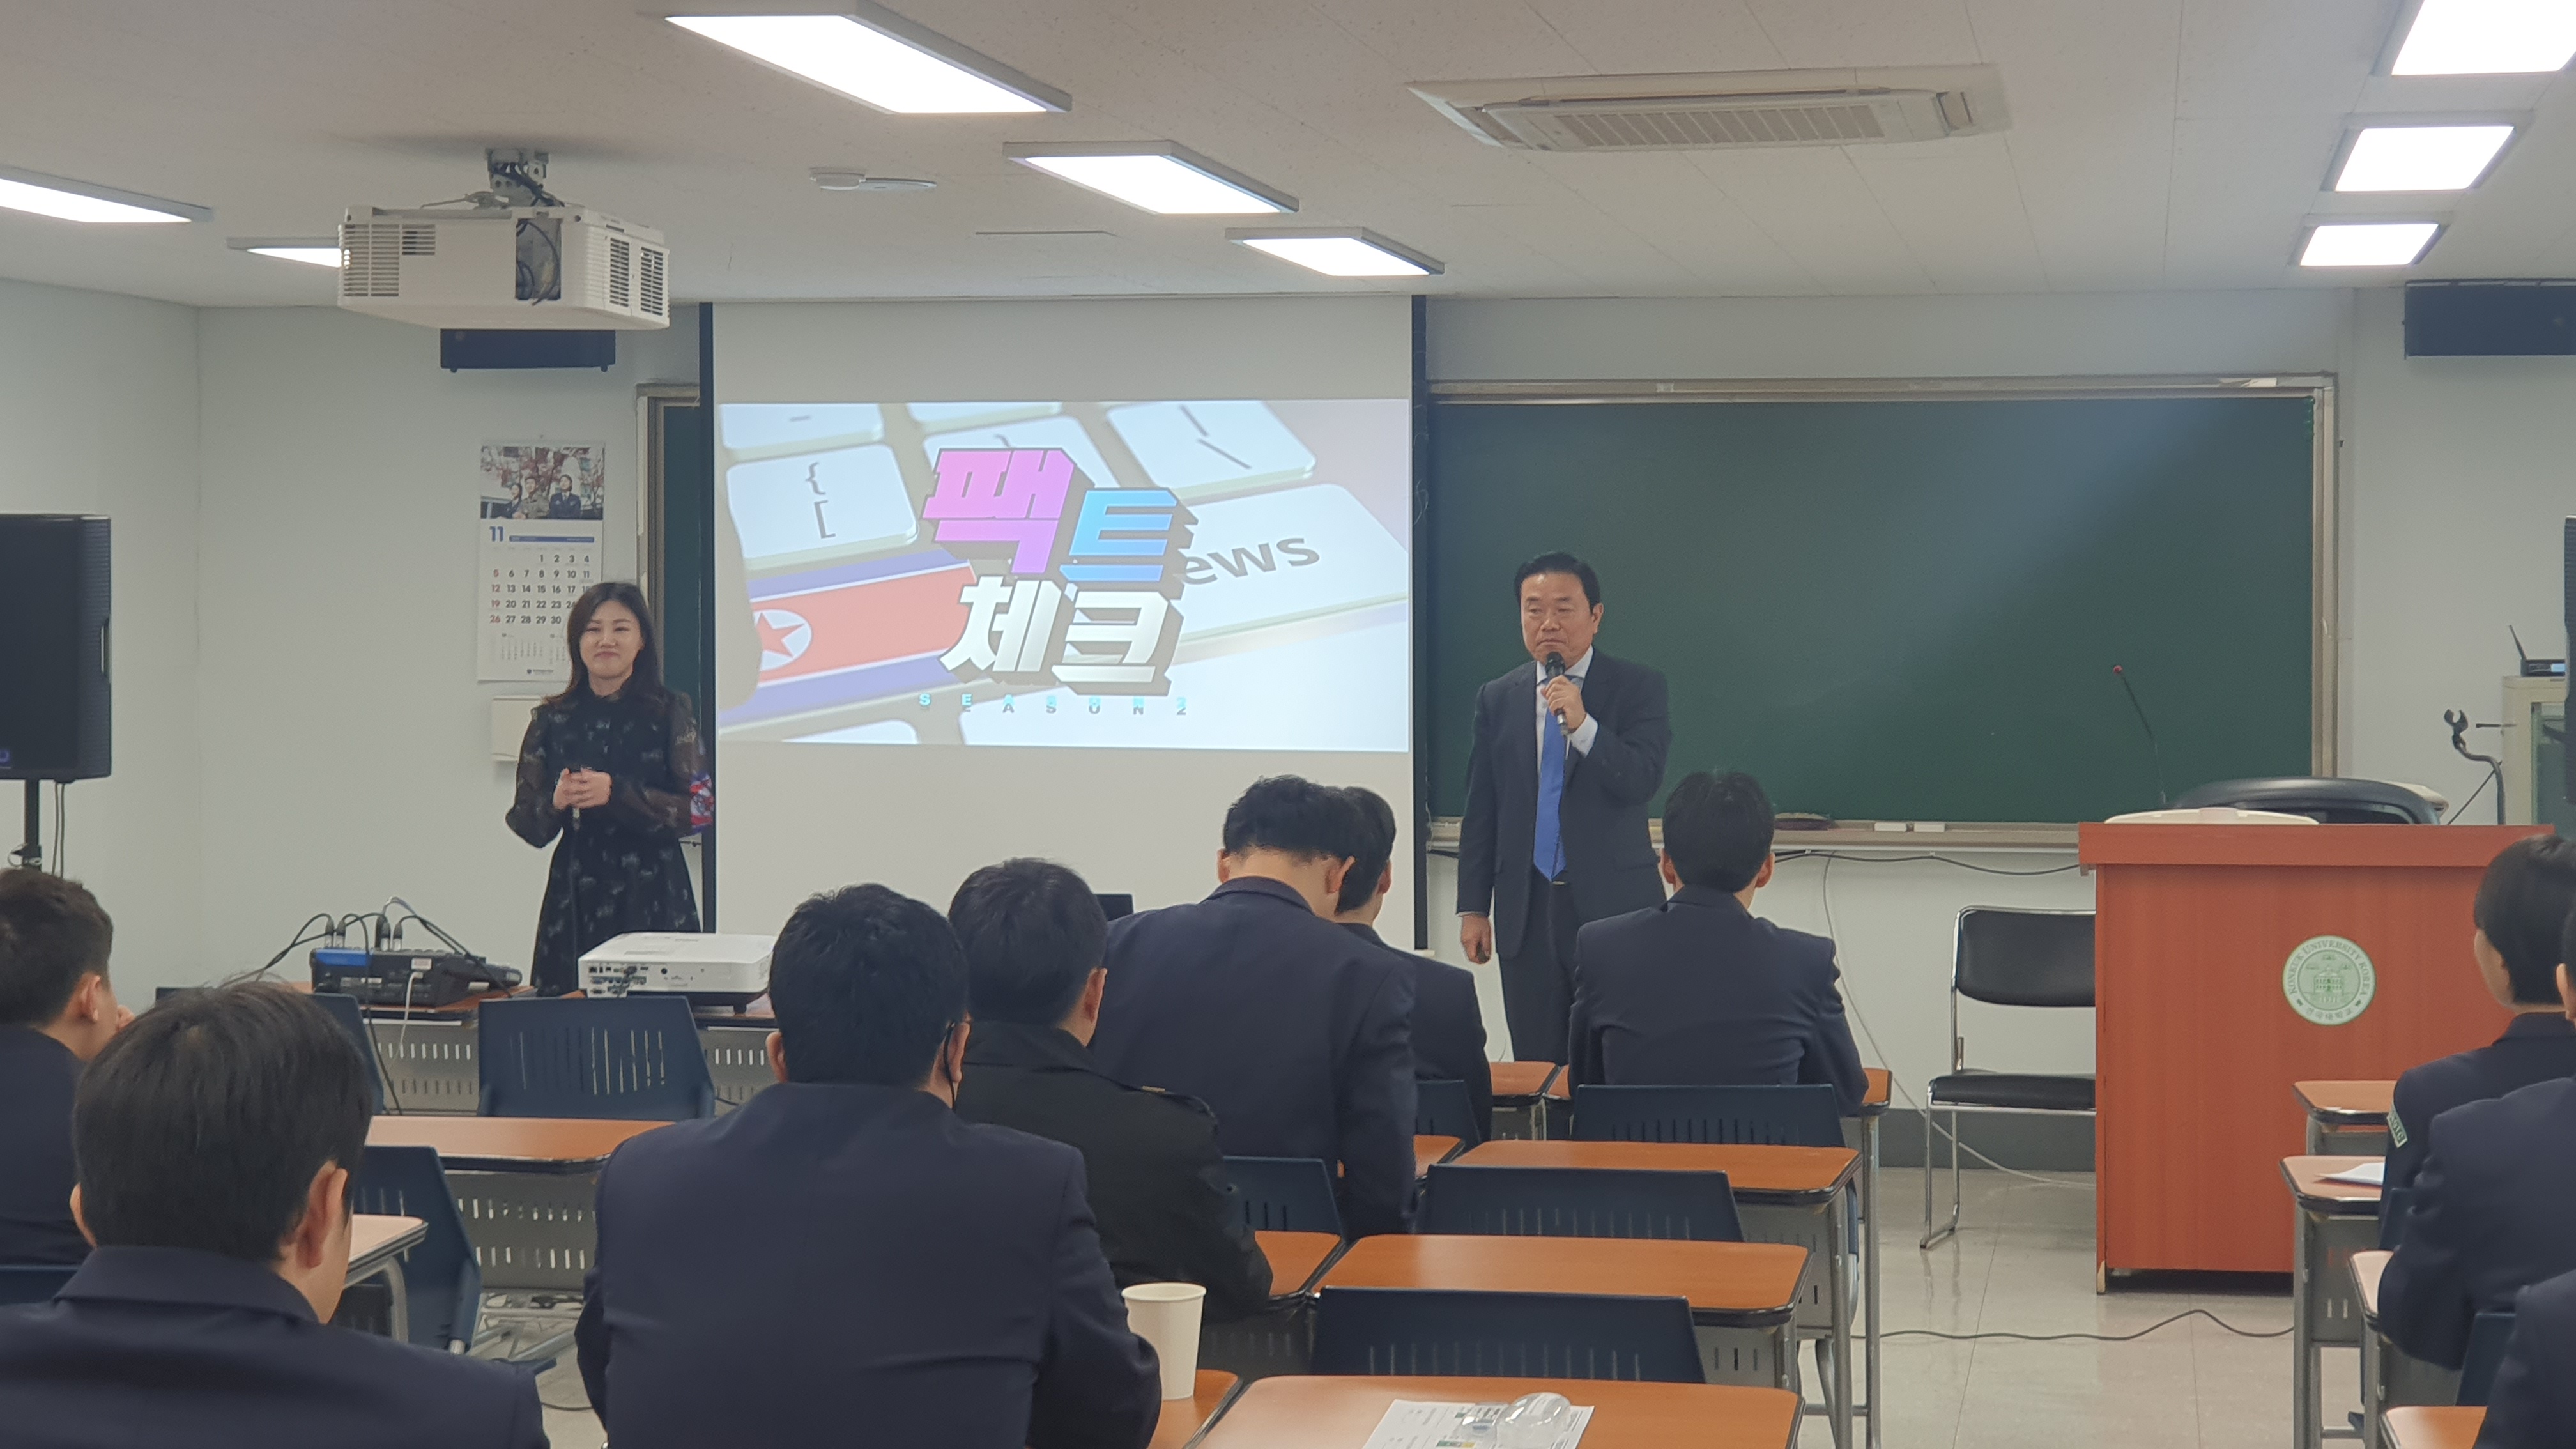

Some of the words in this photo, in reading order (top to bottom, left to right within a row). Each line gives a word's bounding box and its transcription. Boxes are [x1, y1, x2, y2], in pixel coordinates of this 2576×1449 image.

[921, 448, 1177, 583] 팩트
[489, 526, 503, 542] 11
[540, 554, 544, 563] 1
[554, 554, 560, 563] 2
[569, 555, 575, 563] 3
[493, 569, 499, 577] 5
[509, 569, 514, 578] 6
[539, 569, 544, 578] 8
[553, 570, 560, 578] 9
[567, 570, 576, 578] 10
[491, 584, 500, 593] 12
[507, 584, 516, 593] 13
[522, 585, 531, 593] 14
[537, 585, 546, 594] 15
[552, 585, 561, 594] 16
[567, 585, 576, 594] 17
[491, 599, 500, 608] 19
[505, 599, 516, 608] 20
[522, 600, 530, 608] 21
[536, 600, 546, 609] 22
[551, 601, 562, 609] 23
[489, 615, 501, 624] 26
[505, 615, 516, 624] 27
[521, 615, 531, 624] 28
[536, 615, 546, 624] 29
[551, 616, 562, 624] 30
[939, 576, 1170, 683] 체크
[919, 694, 1144, 714] SEASON
